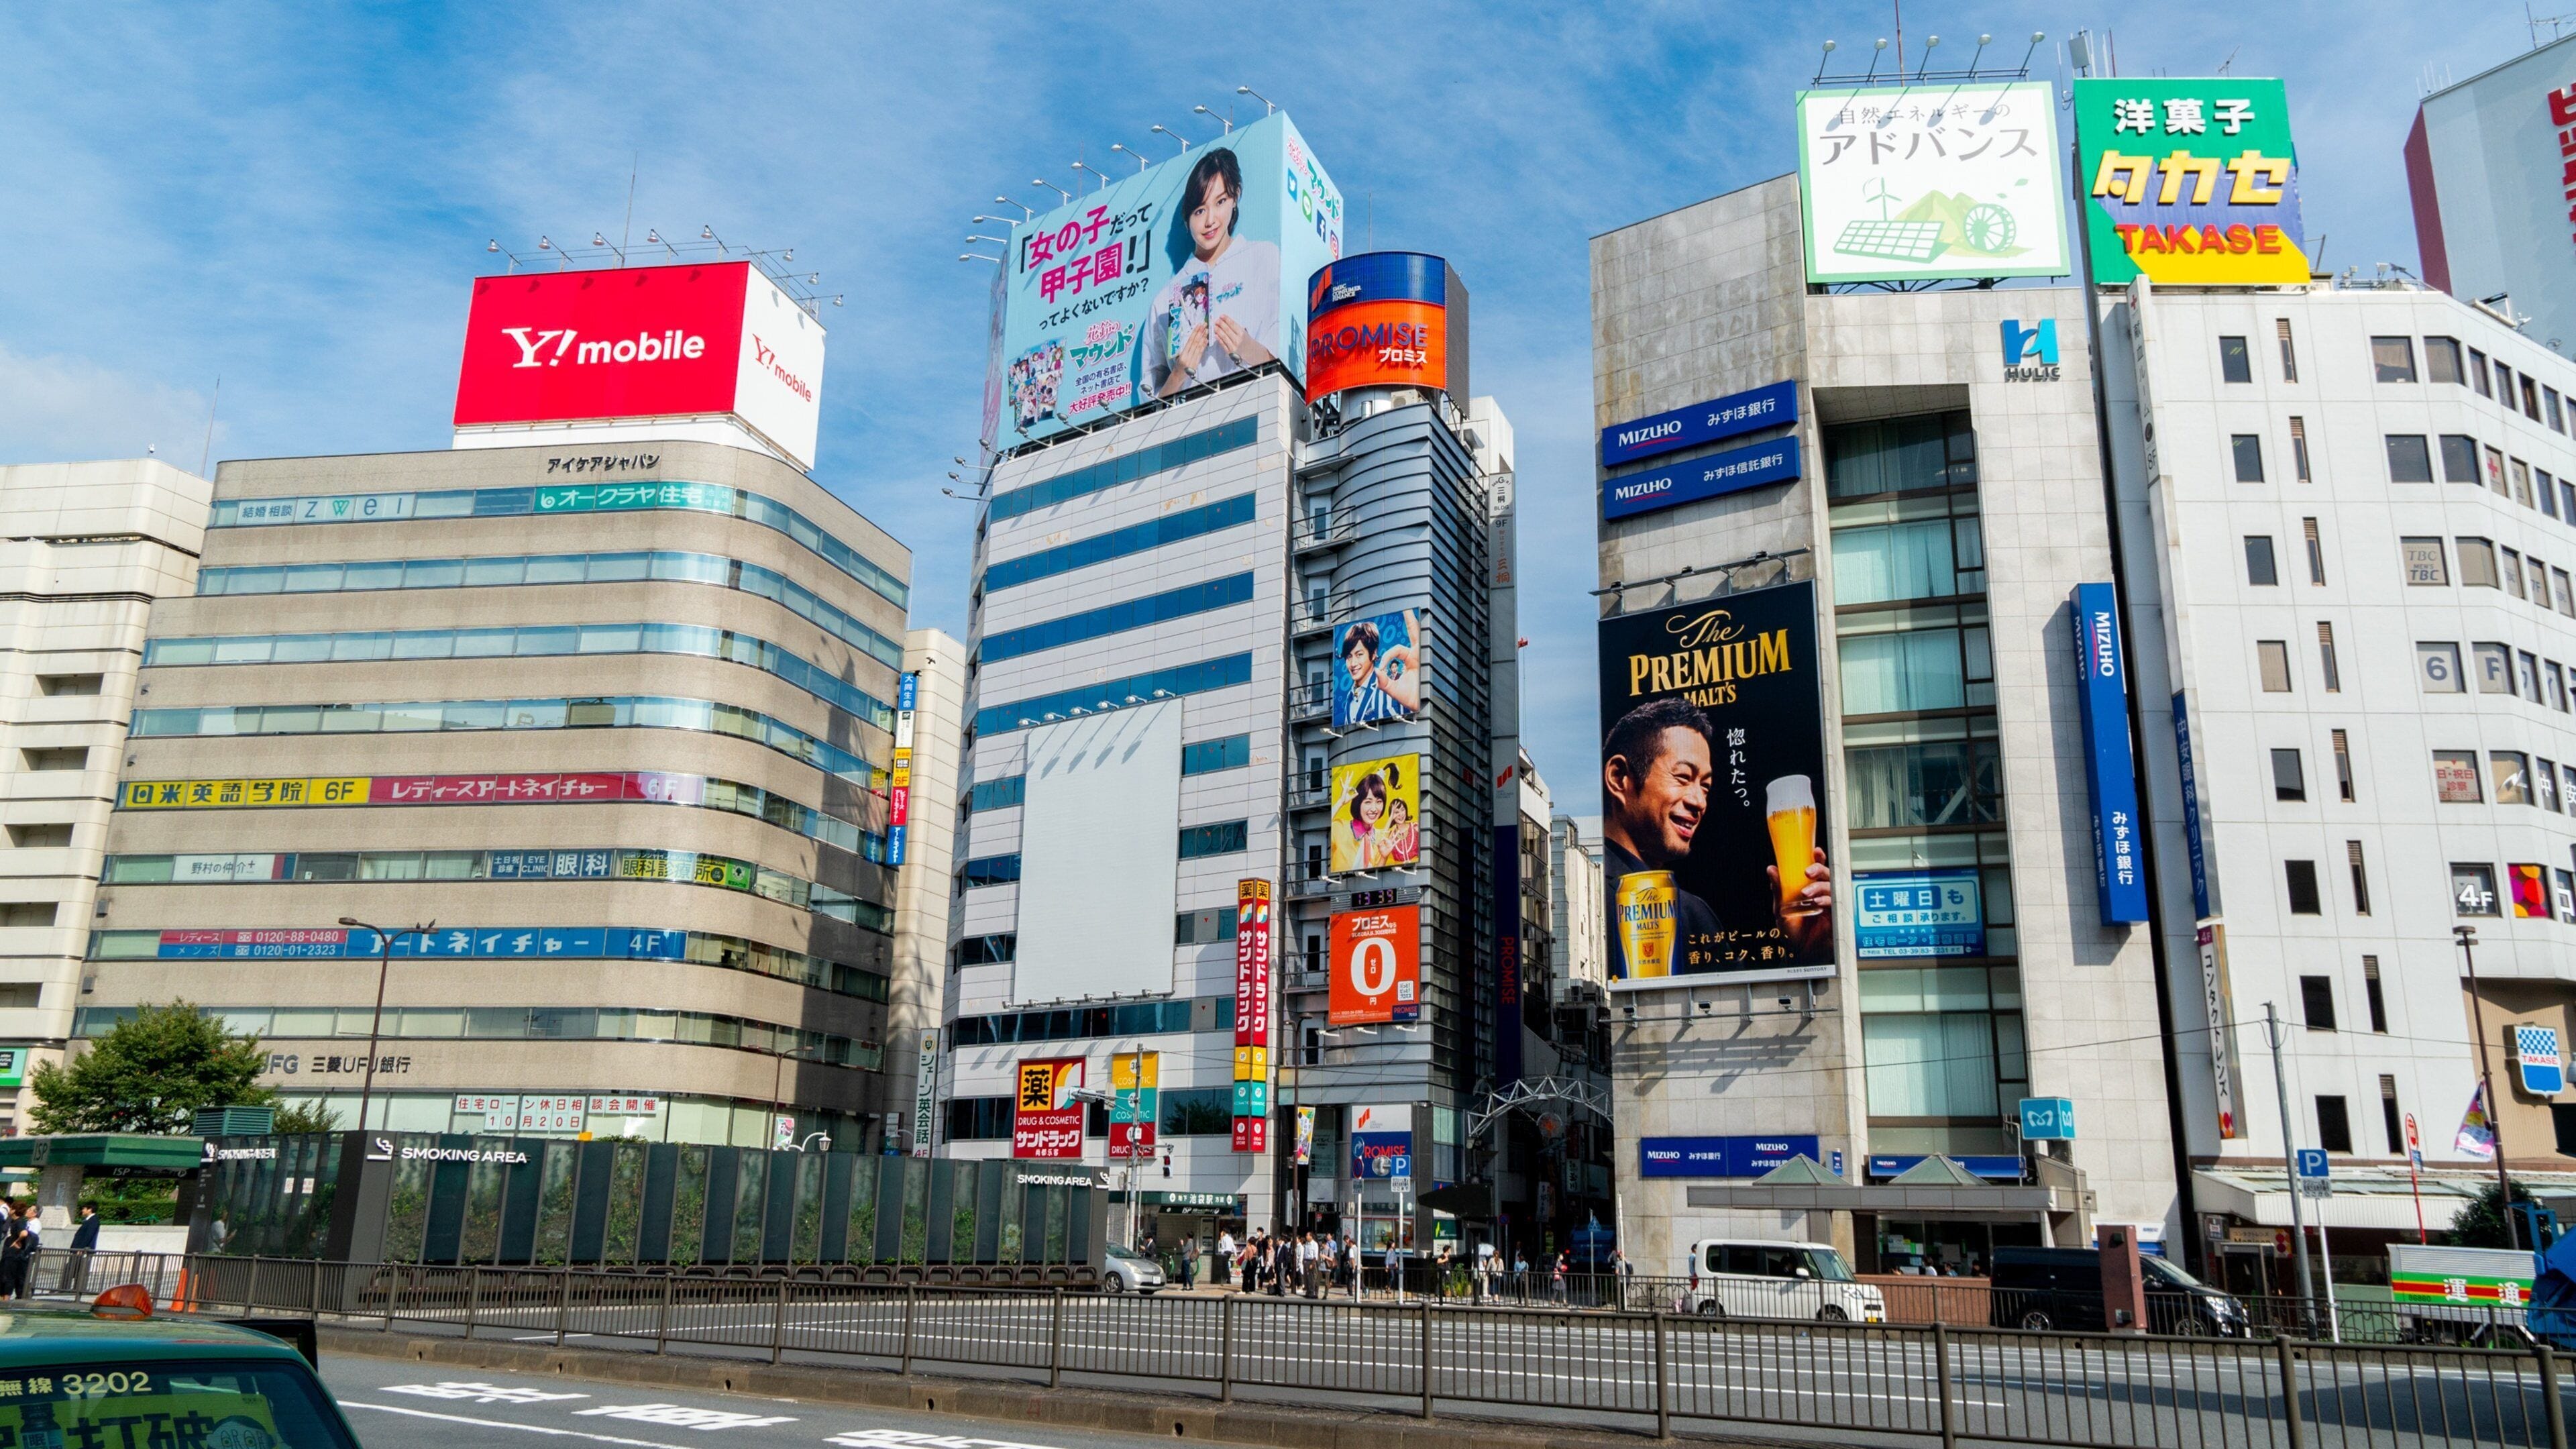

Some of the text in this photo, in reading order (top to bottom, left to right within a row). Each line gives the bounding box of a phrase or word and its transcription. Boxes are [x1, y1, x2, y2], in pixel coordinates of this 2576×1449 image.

[1839, 104, 2010, 124] 自然エネルギーの
[2114, 98, 2255, 133] 洋菓子
[1819, 127, 2037, 165] アドバンス
[2092, 150, 2291, 205] タカセ
[1307, 158, 1340, 222] マウンド
[2115, 224, 2282, 253] TAKASE
[577, 329, 705, 364] mobile
[1070, 321, 1135, 369] マウンド
[1311, 323, 1428, 363] PROMISE
[1379, 348, 1428, 364] プロミス
[775, 366, 812, 402] mobile
[1080, 374, 1122, 394] ネット書店で
[2006, 368, 2060, 381] HULIC
[1619, 398, 1776, 447] MIZUHO みずほ銀行
[547, 454, 660, 473] アイケアジャパン
[1615, 453, 1783, 500] MIZUHO みずほ信託銀行
[559, 486, 702, 505] オークラヤ住宅
[242, 504, 292, 518] 結婚相談
[2407, 551, 2436, 561] TBC
[2410, 570, 2439, 581] TBC
[1666, 610, 1744, 648] The
[2075, 616, 2086, 680] MIZUHO
[2095, 612, 2114, 677] MIZUHO
[1628, 629, 1792, 696] PREMIUM
[903, 675, 913, 708] 大同生命
[1683, 682, 1737, 707] MALT'S
[392, 780, 677, 798] レディースアートネイチャー 6F
[895, 776, 908, 786] 6F
[132, 781, 355, 804] 日米英語学院 6F
[2112, 812, 2133, 885] みずほ銀行
[494, 856, 519, 865] 土日祝
[497, 865, 514, 873] 診療
[555, 853, 608, 876] 眼科
[623, 860, 710, 881] 眼科診療所
[1241, 883, 1252, 898] 薬
[1258, 883, 1269, 898] 薬
[1630, 887, 1662, 902] The
[1870, 889, 1964, 908] 土曜日も
[2459, 883, 2493, 906] 4F
[1618, 900, 1676, 923] PREMIUM
[1872, 912, 1966, 924] ご相談承ります。
[1636, 920, 1659, 931] MALT'S
[180, 931, 339, 943] レディース 0120-88-0480
[370, 932, 661, 954] アートネイチャー 4F
[1688, 927, 1789, 945] これがビールの、
[2201, 932, 2211, 941] 4F
[177, 945, 335, 956] メンズ 0120-01-2323
[1688, 946, 1794, 965] 香り、コク、香り。
[1351, 937, 1397, 996] 0
[1370, 958, 1376, 973] ゼロ
[1501, 937, 1515, 1004] PROMISE
[1238, 930, 1252, 1032] サンドラッグ
[1254, 930, 1268, 1032] サンドラッグ
[2205, 955, 2227, 1096] コンタクトレンズ
[311, 1056, 411, 1074] 三菱UFJ銀行
[2522, 1055, 2558, 1065] TAKASE
[1023, 1069, 1050, 1107] 薬
[458, 1097, 657, 1112] 住宅ローン休日相談会開催
[916, 1055, 934, 1144] シェーン英会話
[489, 1116, 580, 1128] 10月20日
[1018, 1116, 1080, 1126] DRUG & COSMETIC
[1016, 1130, 1080, 1148] サンドラッグ
[401, 1147, 528, 1164] SMOKING AREA
[1364, 1146, 1405, 1159] ROMISE
[1648, 1151, 1680, 1159] MIZUHO
[113, 1168, 131, 1176] ISP
[1396, 1158, 1406, 1174] P
[2306, 1151, 2322, 1174] P
[1018, 1175, 1092, 1186] SMOKING AREA
[63, 1372, 152, 1394] 3202
